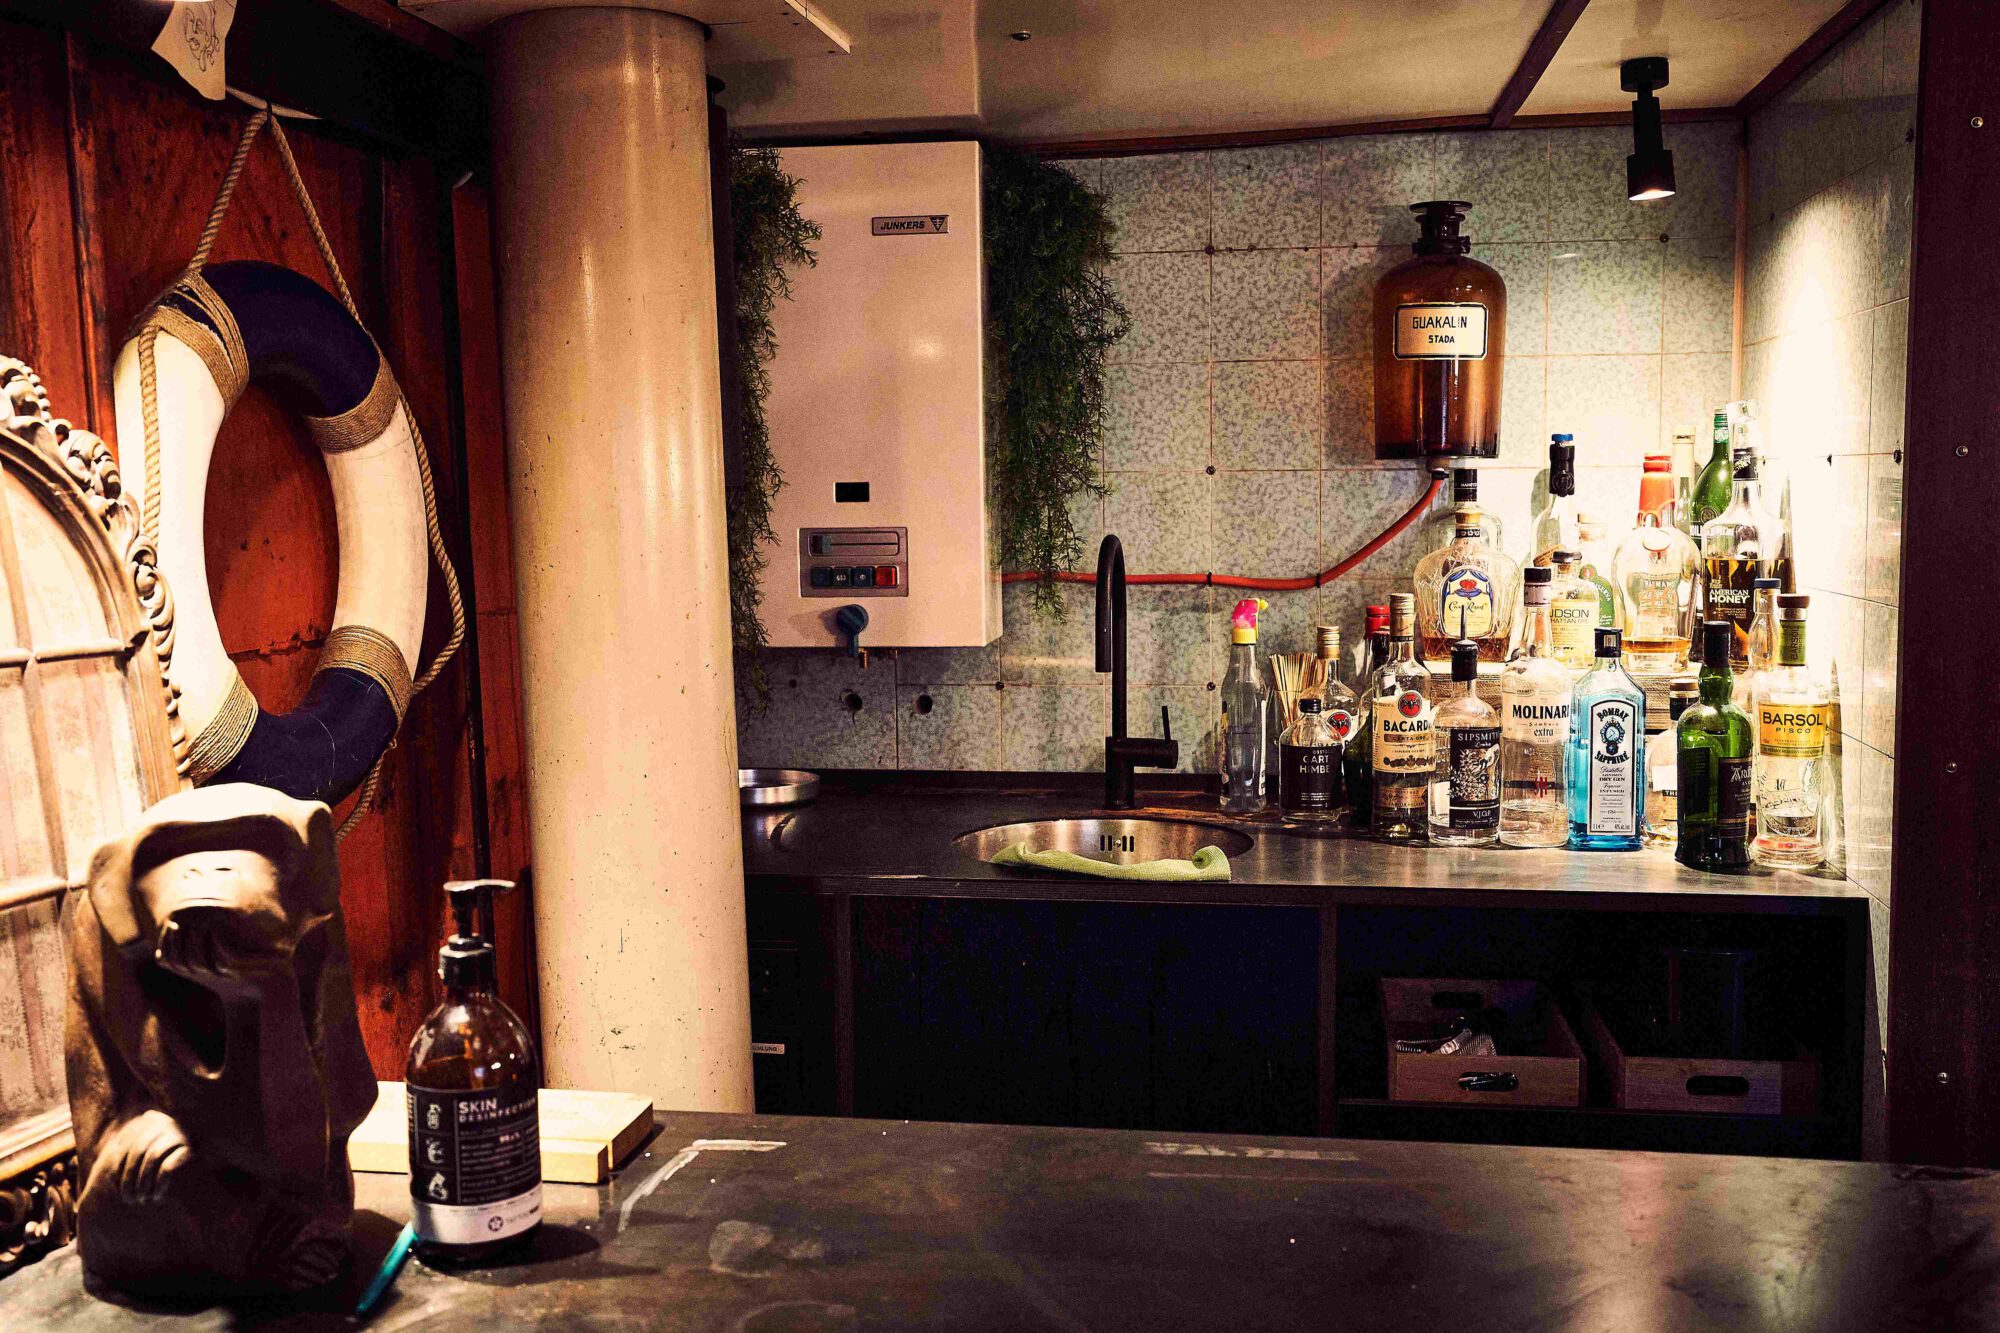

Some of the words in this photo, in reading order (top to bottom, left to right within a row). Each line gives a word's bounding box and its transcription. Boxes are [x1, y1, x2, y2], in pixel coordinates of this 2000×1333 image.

[881, 221, 925, 230] JUNKERS
[1412, 316, 1467, 329] GUAKALIN
[1428, 335, 1455, 343] STADA
[1709, 594, 1747, 604] HONEY
[1466, 601, 1485, 613] Royal
[1789, 626, 1799, 660] BARSOL
[1596, 708, 1629, 722] BOMBAY
[1763, 711, 1823, 727] BARSOL
[1533, 728, 1554, 737] extra
[1594, 750, 1630, 765] SAPPHIRE
[459, 1097, 497, 1114] SKIN
